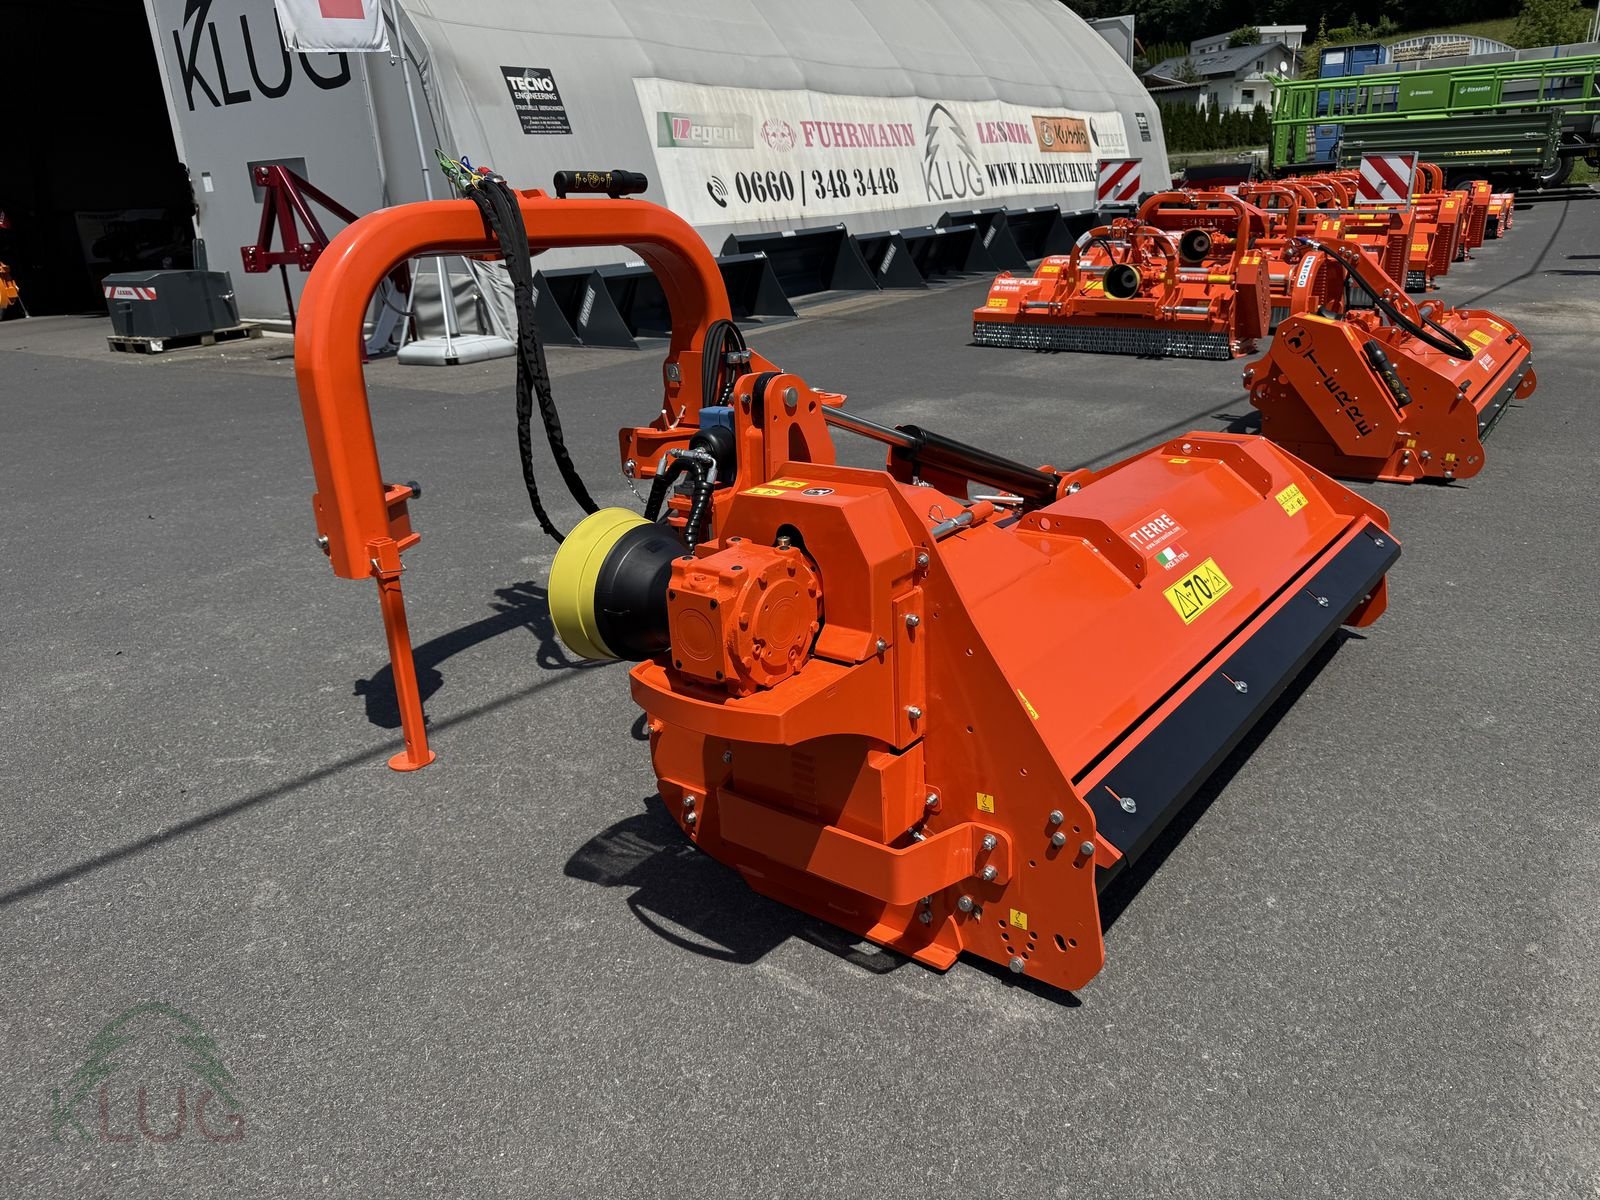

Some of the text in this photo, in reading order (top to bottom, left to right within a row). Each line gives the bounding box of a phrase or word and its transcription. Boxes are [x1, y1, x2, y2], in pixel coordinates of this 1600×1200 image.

[506, 76, 554, 91] TECNO
[514, 91, 558, 100] ENGINEERING
[799, 120, 916, 148] FUHRMANN
[976, 121, 1032, 145] LESNIK
[1053, 124, 1087, 146] Kubota
[735, 170, 795, 204] 0660
[811, 169, 851, 200] 348
[853, 167, 899, 197] 3448
[921, 161, 985, 203] KLUG
[985, 161, 1098, 188] WWW.LANDTECHNIK-
[1303, 349, 1373, 437] TIERRE
[1129, 513, 1175, 545] TIERRE
[1183, 575, 1213, 606] 70
